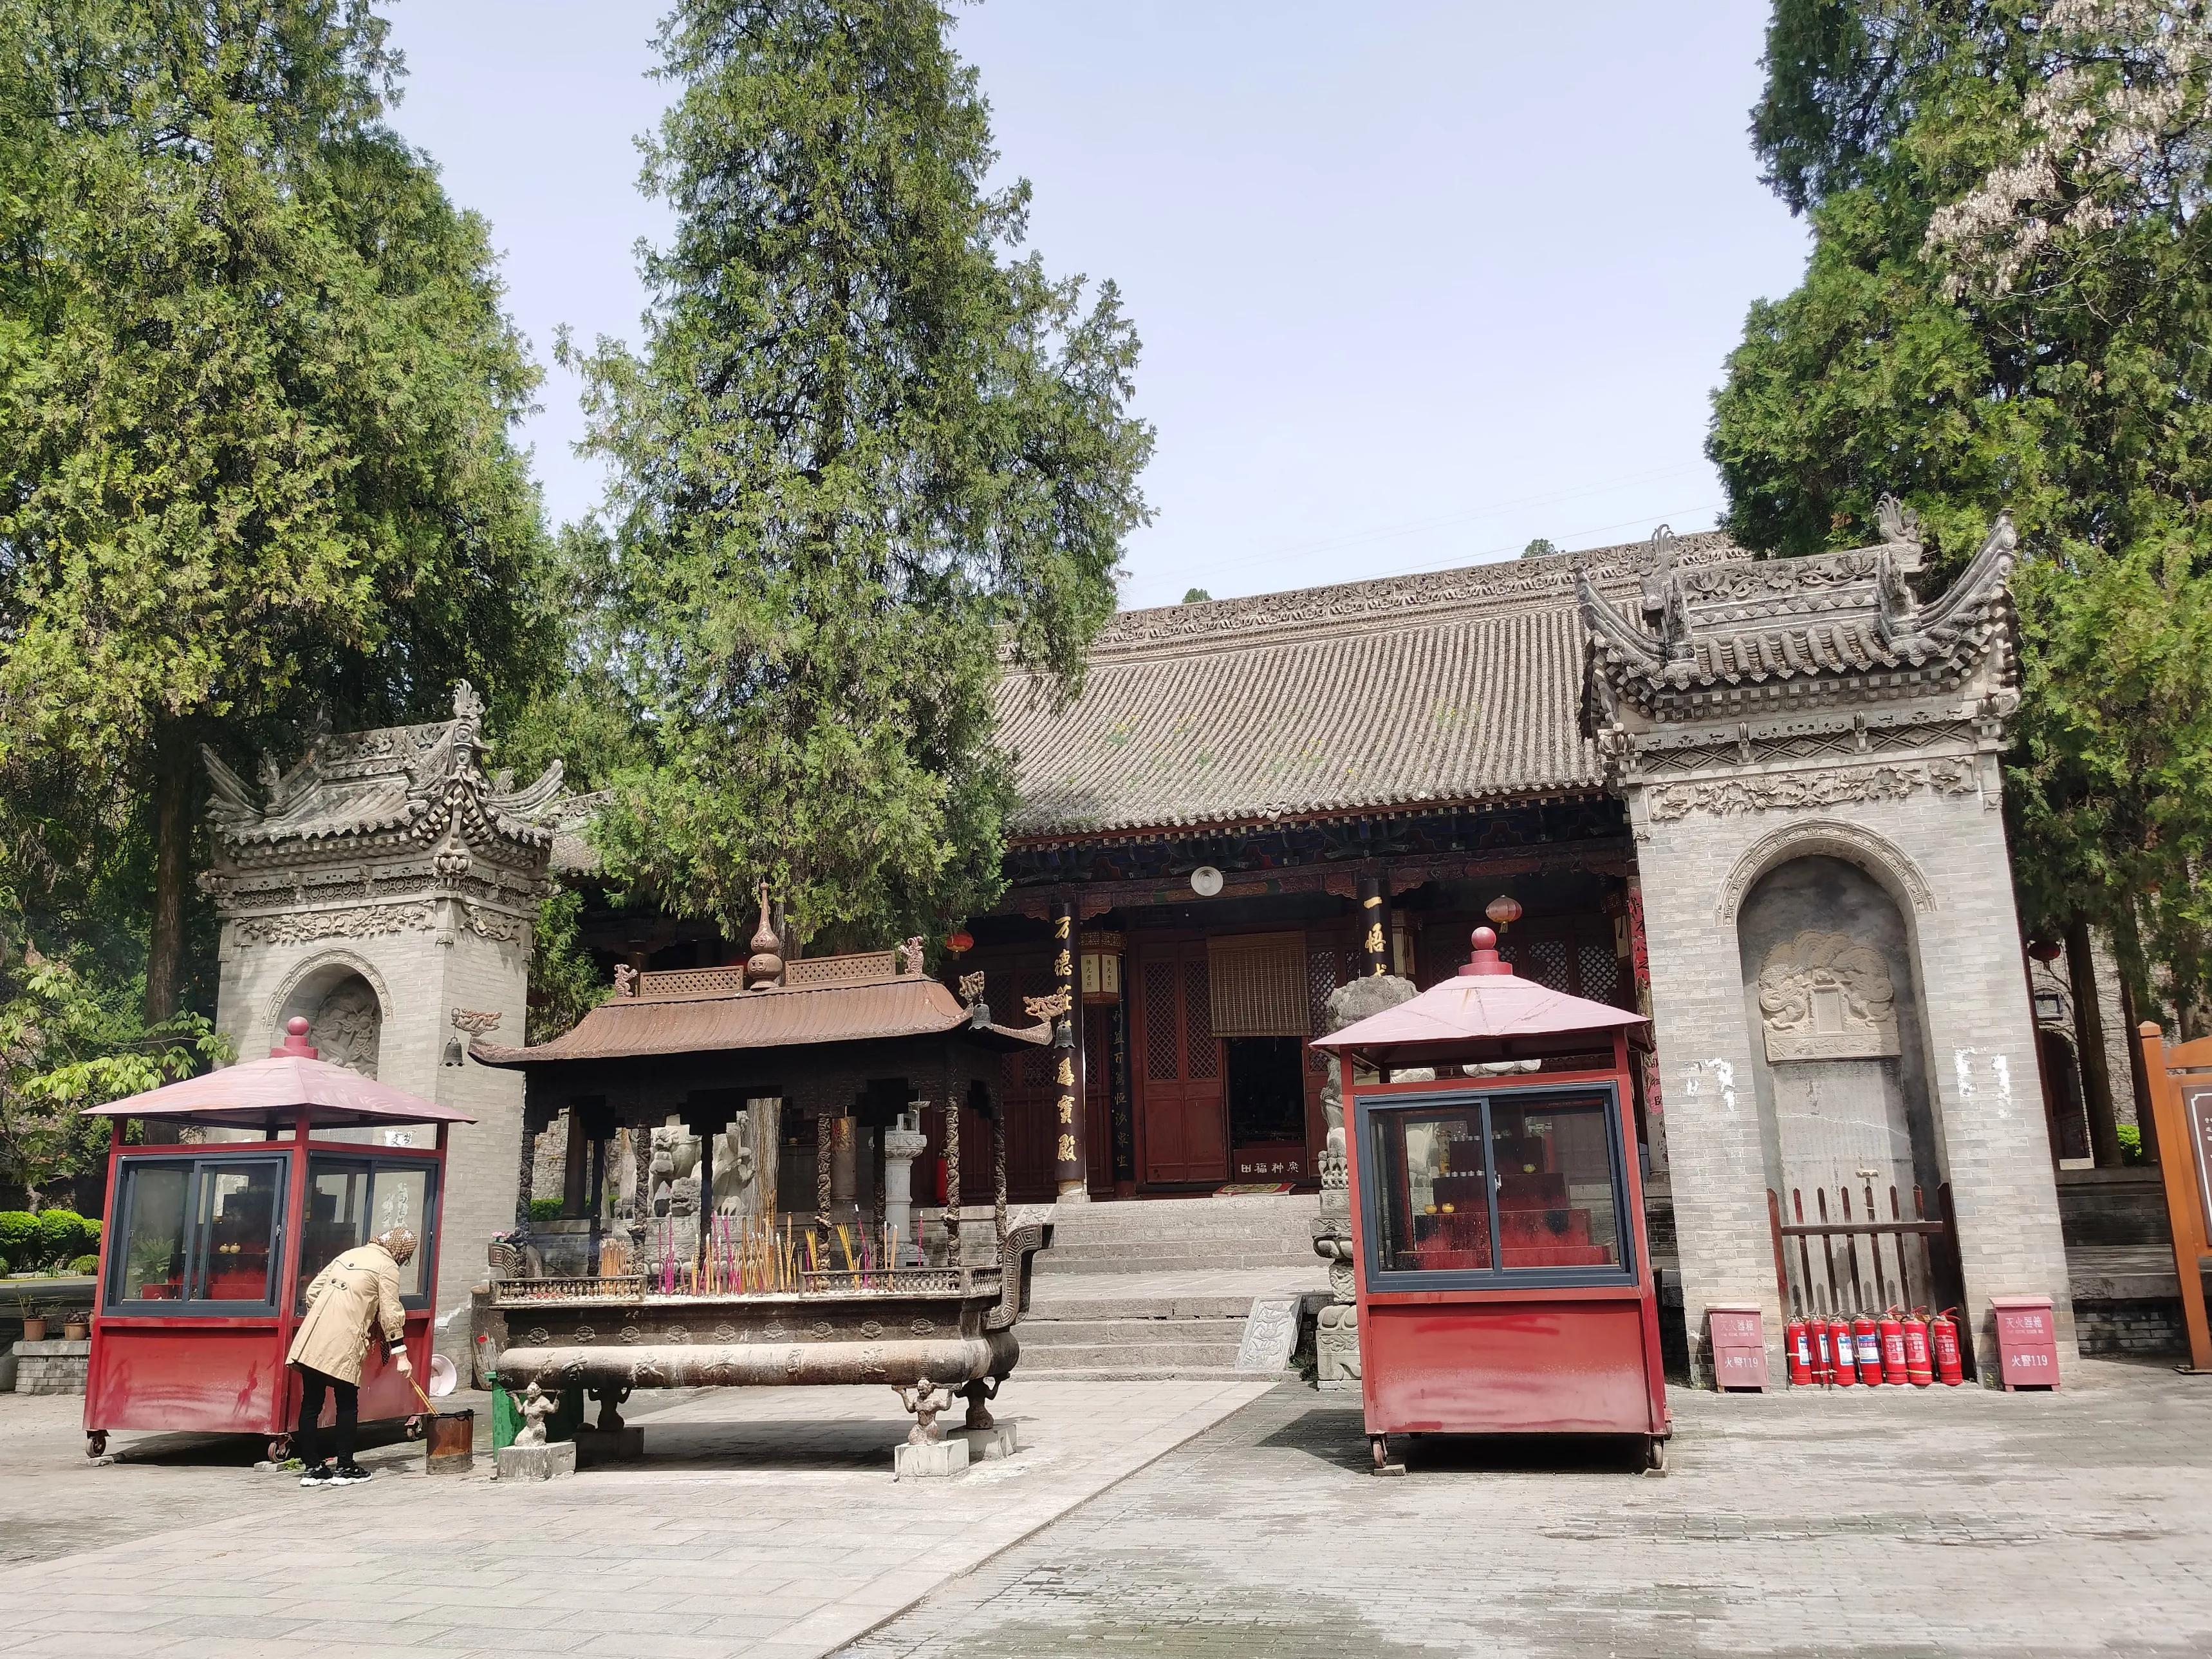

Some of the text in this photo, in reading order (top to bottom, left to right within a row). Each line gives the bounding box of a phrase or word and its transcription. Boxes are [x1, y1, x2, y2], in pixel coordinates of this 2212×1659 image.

[2005, 1315, 2042, 1328] 灭火器箱
[1724, 1356, 1758, 1369] 火警119
[2012, 1354, 2048, 1367] 火警119
